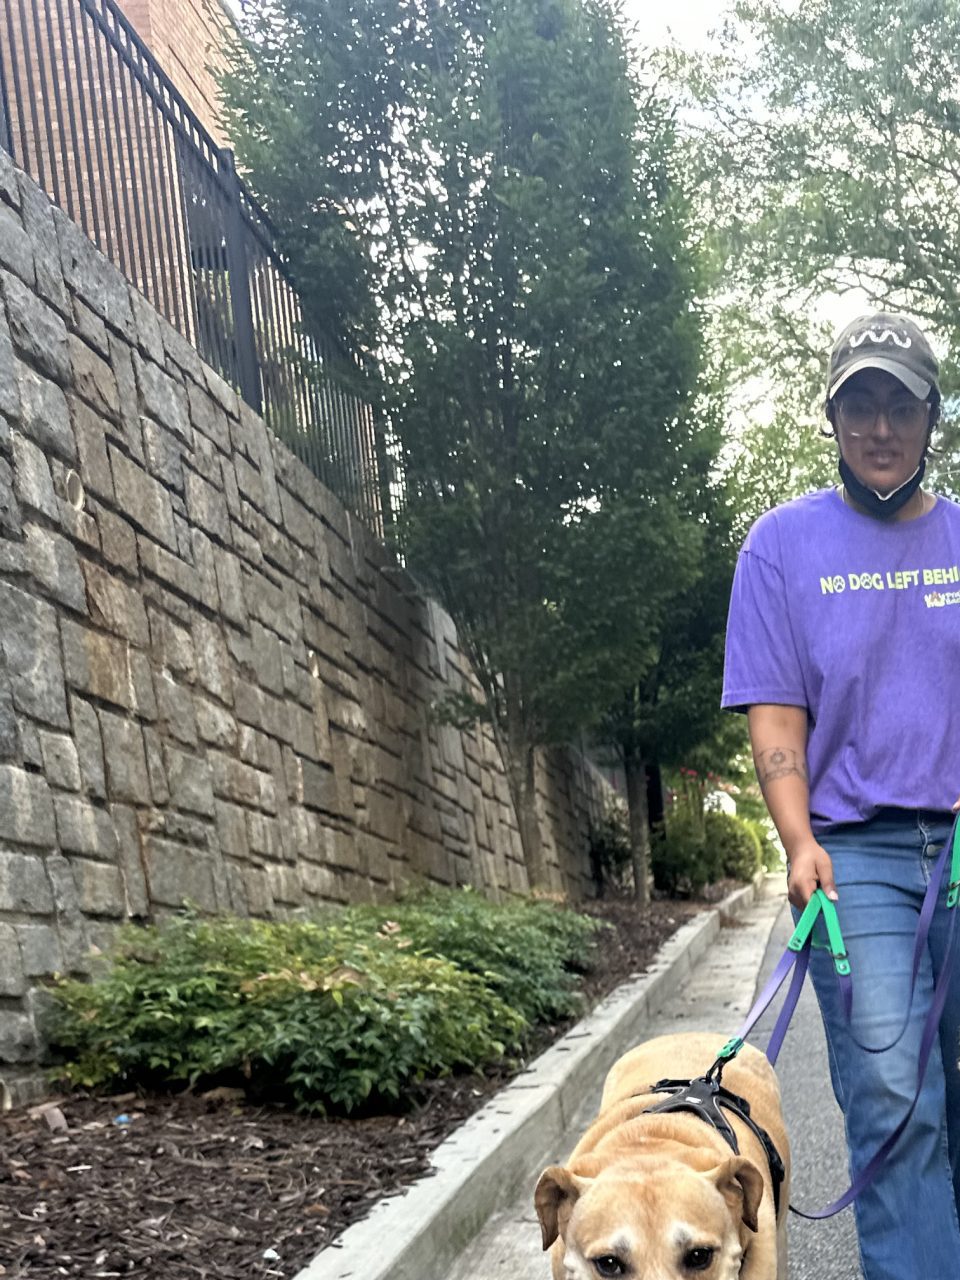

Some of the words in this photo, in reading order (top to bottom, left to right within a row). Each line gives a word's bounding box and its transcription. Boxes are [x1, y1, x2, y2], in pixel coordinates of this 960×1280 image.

[820, 575, 845, 594] NO
[848, 573, 884, 591] DOG
[886, 570, 919, 589] LEFT
